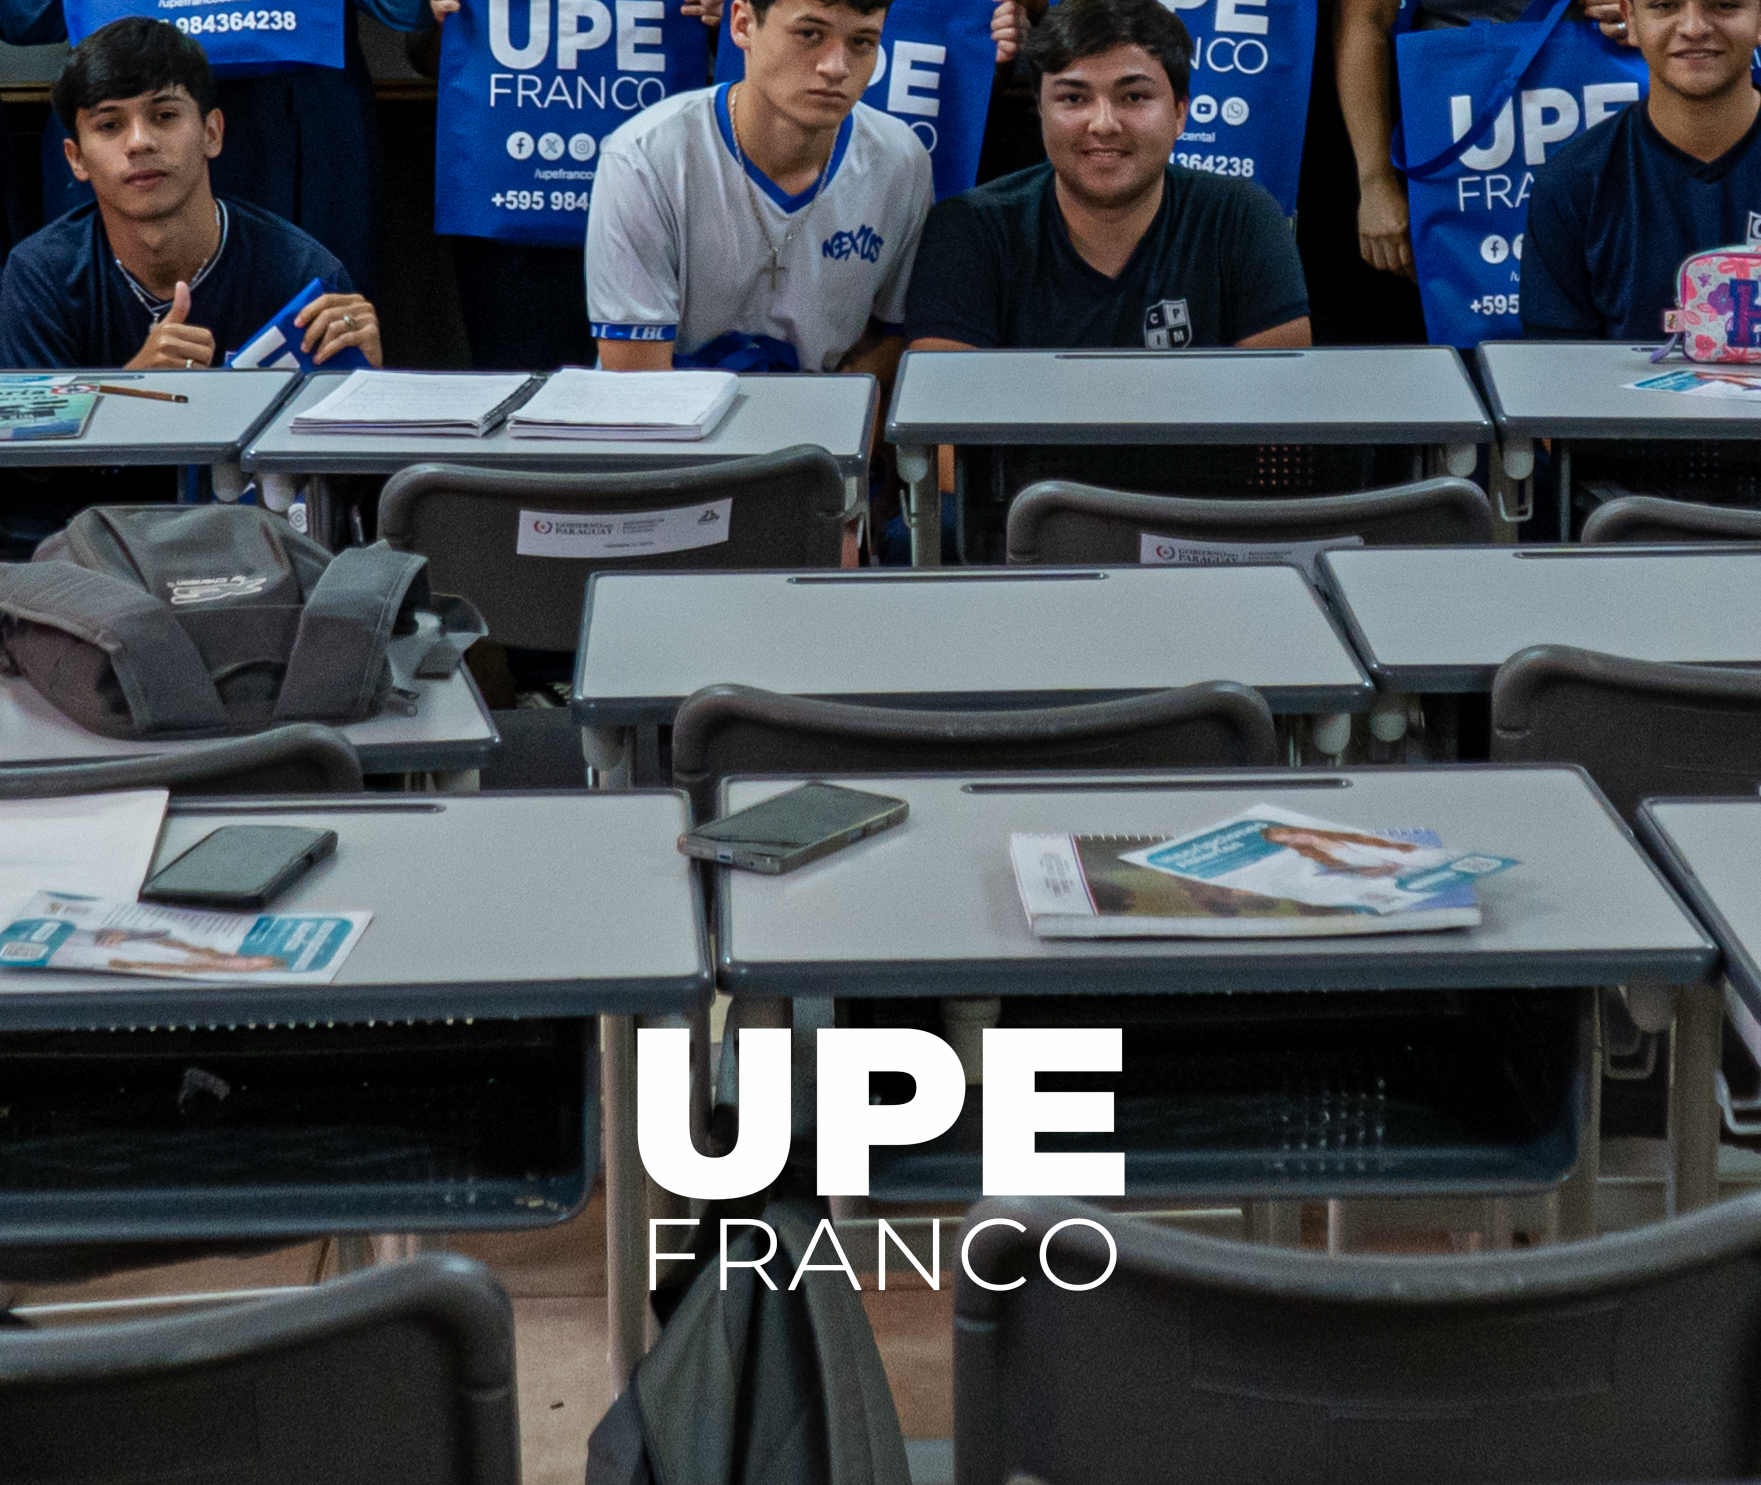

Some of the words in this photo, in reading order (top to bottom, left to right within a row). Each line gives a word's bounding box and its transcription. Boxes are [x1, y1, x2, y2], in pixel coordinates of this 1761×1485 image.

[176, 11, 297, 34] 984364238
[490, 74, 666, 110] FRANCO
[491, 190, 545, 210] +595
